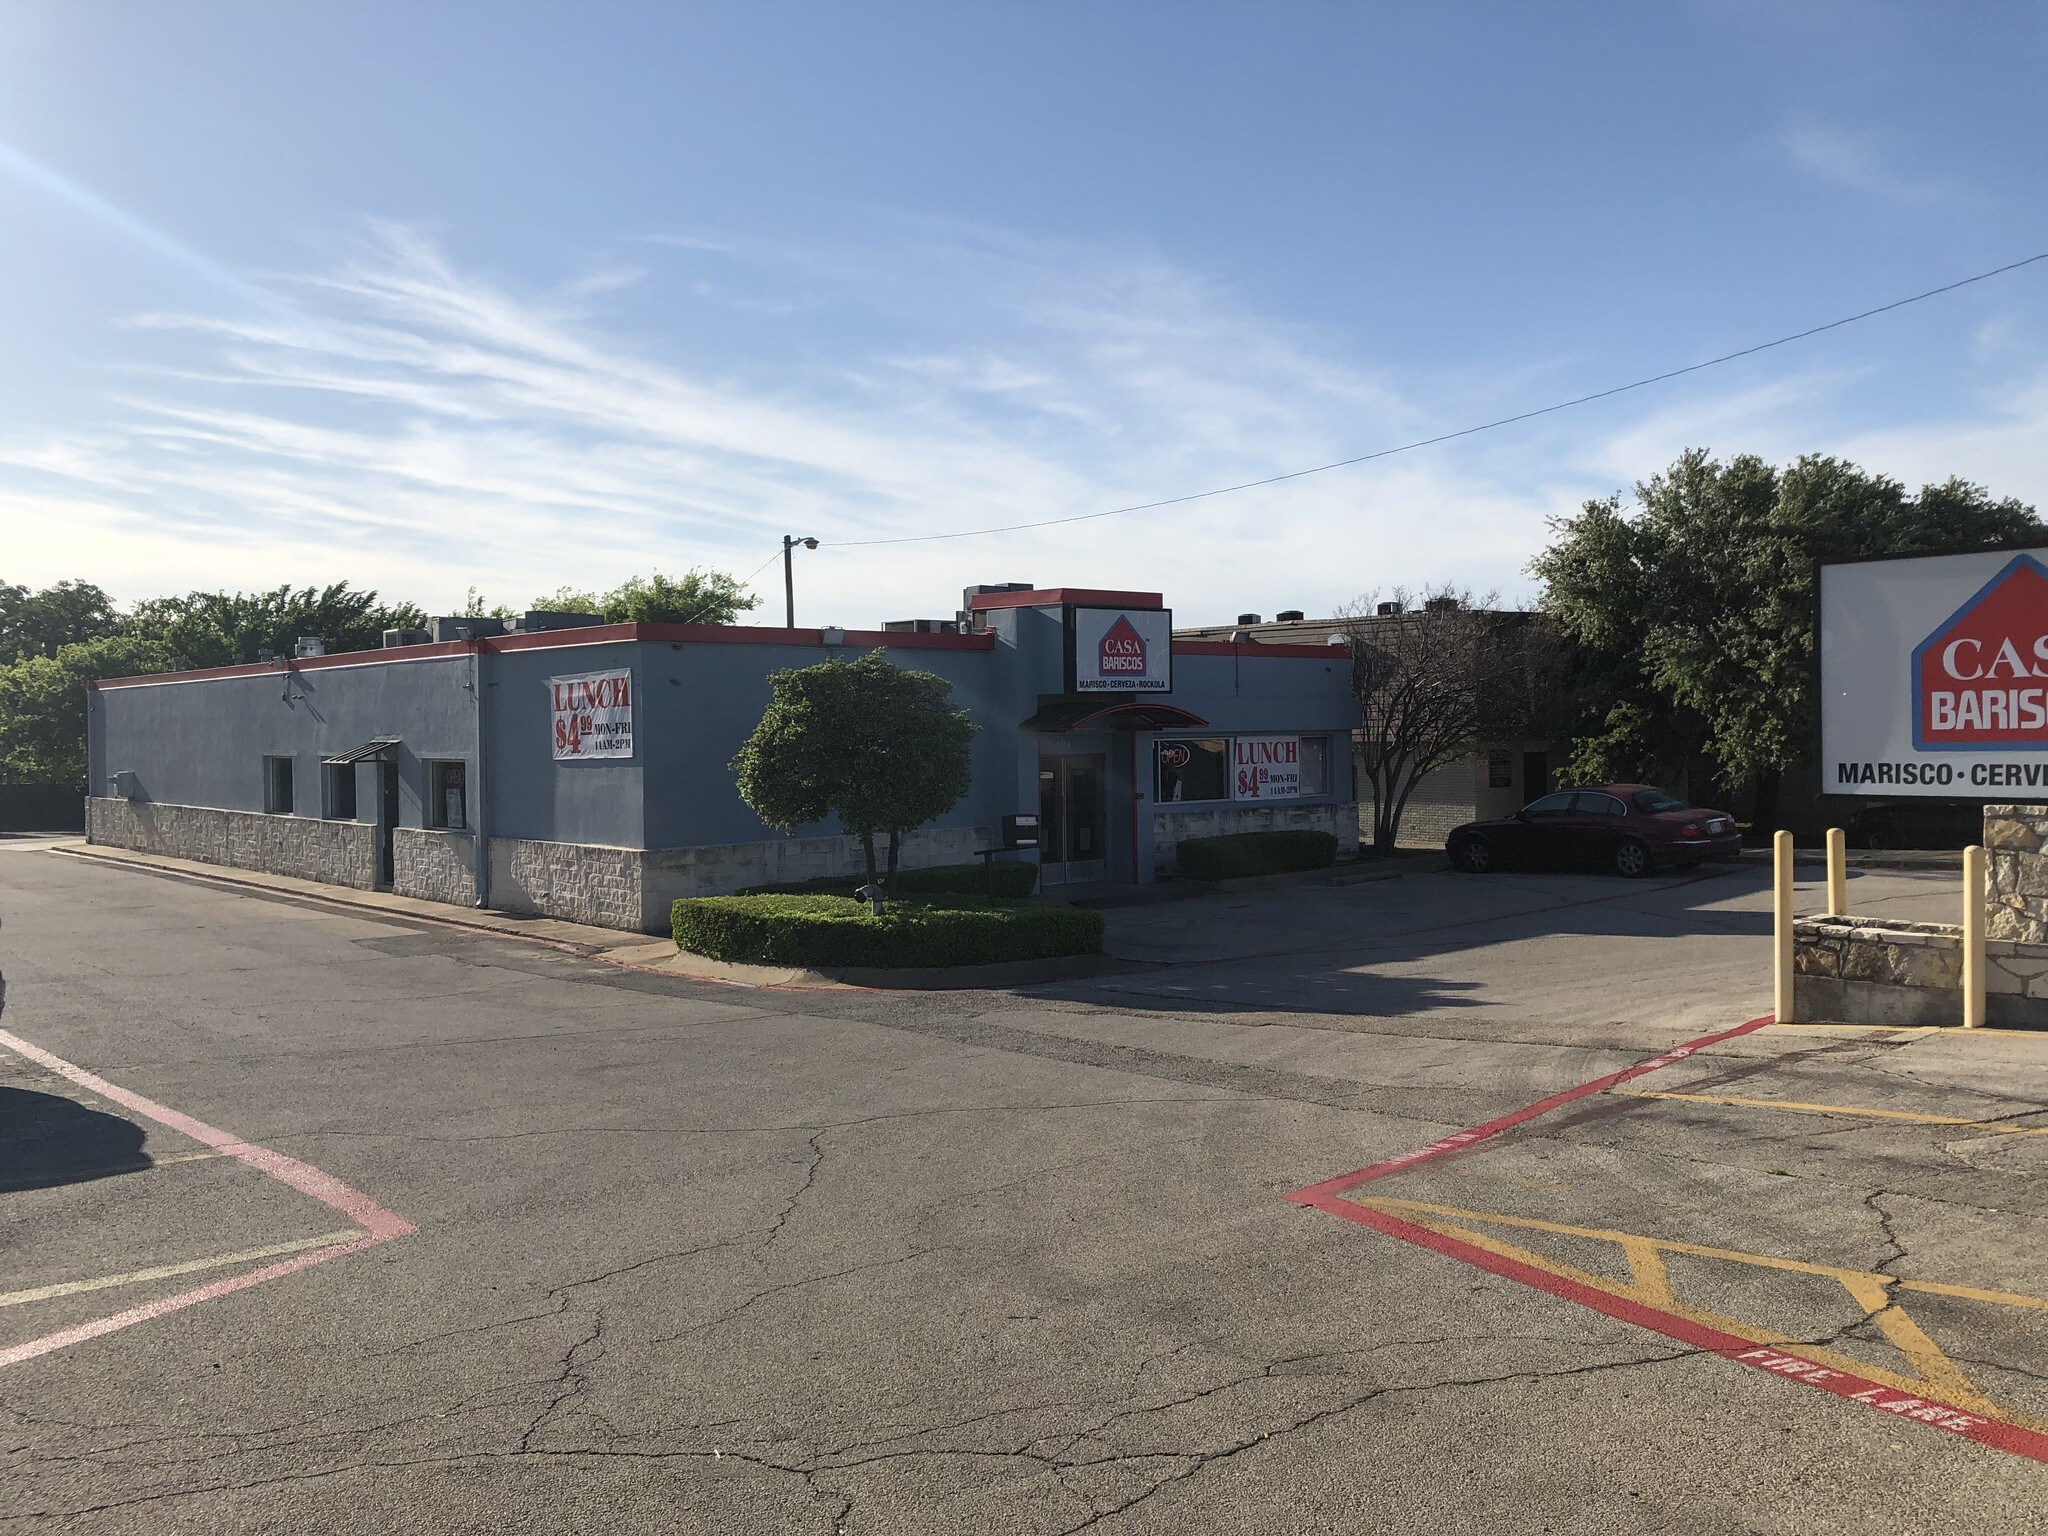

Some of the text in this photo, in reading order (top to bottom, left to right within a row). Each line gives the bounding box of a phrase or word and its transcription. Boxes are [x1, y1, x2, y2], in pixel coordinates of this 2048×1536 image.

[1105, 639, 1141, 654] CASA
[1102, 656, 1143, 670] BARISCOS
[1080, 680, 1165, 688] MARISCO CERVEZA ROCKOLA
[553, 677, 631, 711] LUNCH
[1930, 688, 2048, 731] BARIS
[594, 722, 631, 736] MON-FRI
[594, 738, 631, 751] 11AM-2PM
[1161, 749, 1185, 763] OPEN
[1237, 741, 1298, 765] LUNCH
[1270, 773, 1298, 784] MON-FRI
[1838, 762, 1953, 786] MARISCO
[1736, 1349, 1989, 1432] FIRE LANE
